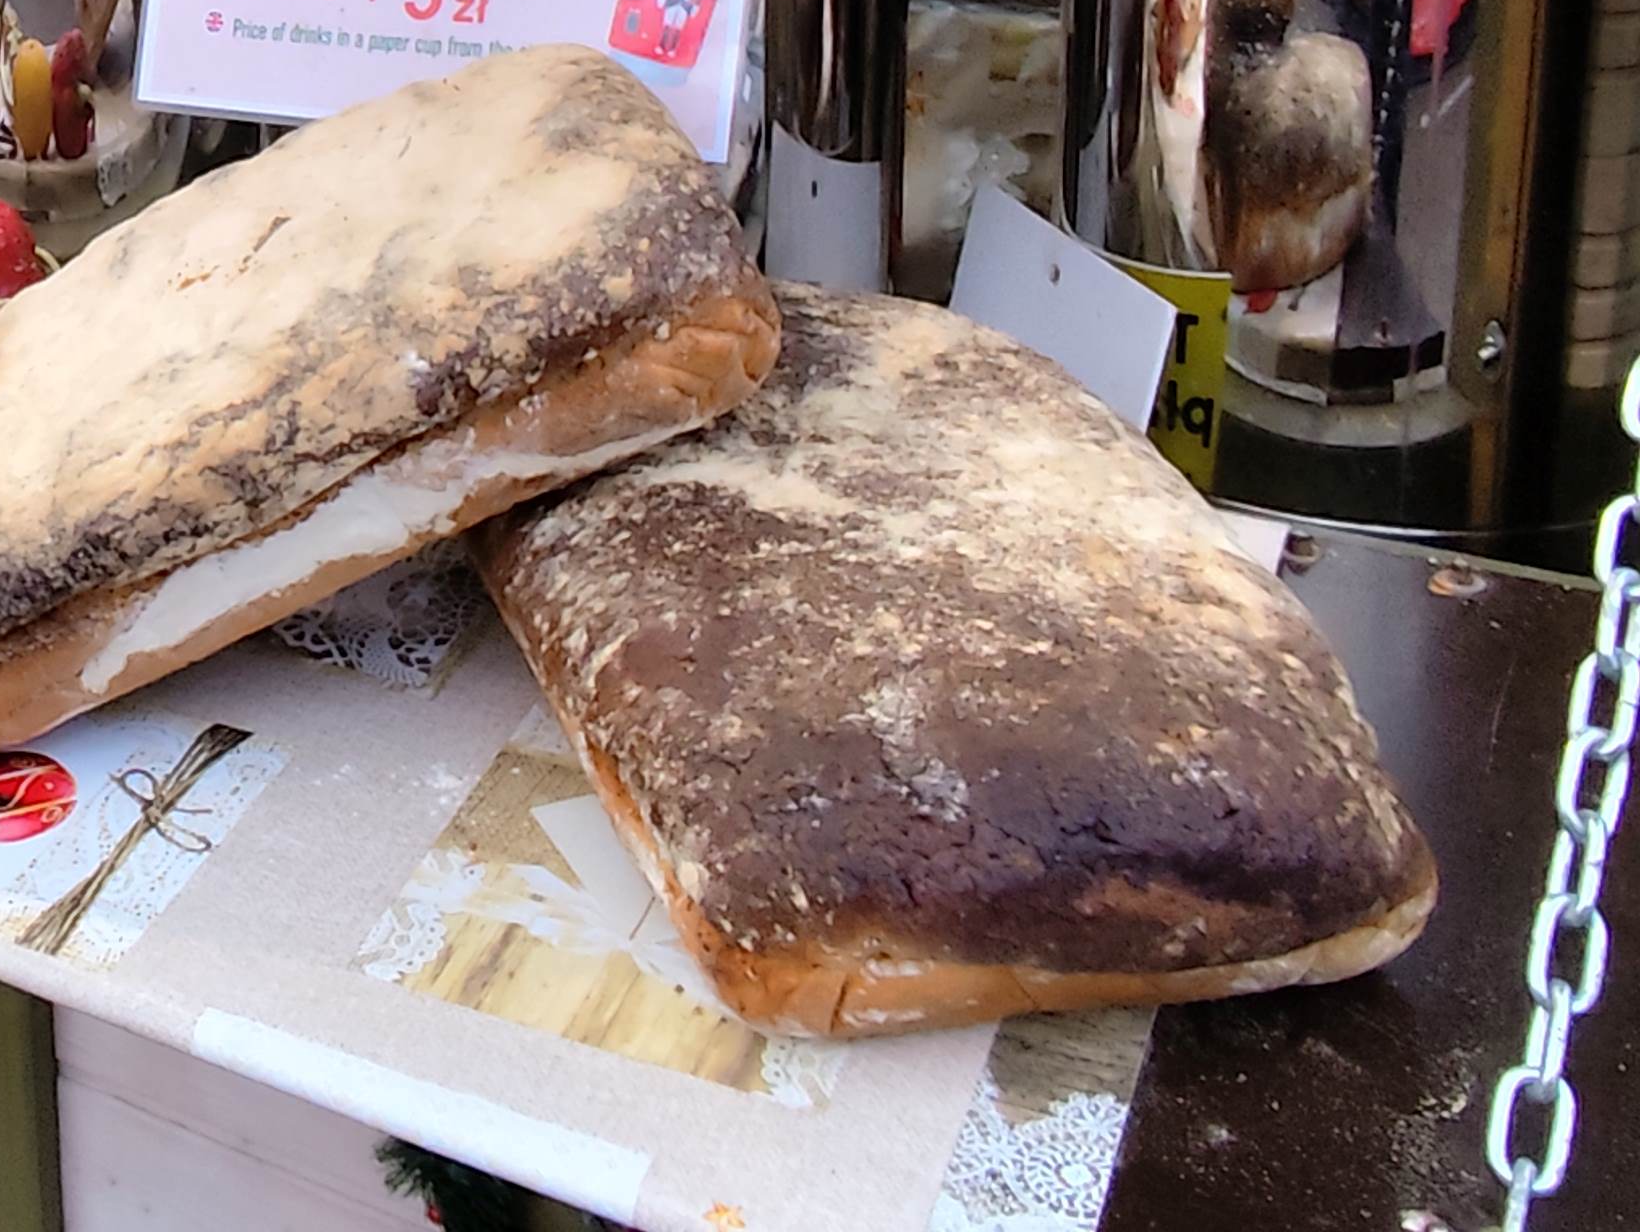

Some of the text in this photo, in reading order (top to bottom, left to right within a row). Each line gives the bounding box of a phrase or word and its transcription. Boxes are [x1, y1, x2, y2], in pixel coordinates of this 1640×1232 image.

[232, 18, 268, 39] Price
[271, 22, 286, 41] of
[289, 23, 332, 45] drinks
[337, 27, 350, 45] in
[354, 32, 364, 48] a
[368, 34, 410, 54] paper
[414, 39, 442, 58] cup
[447, 35, 483, 58] from
